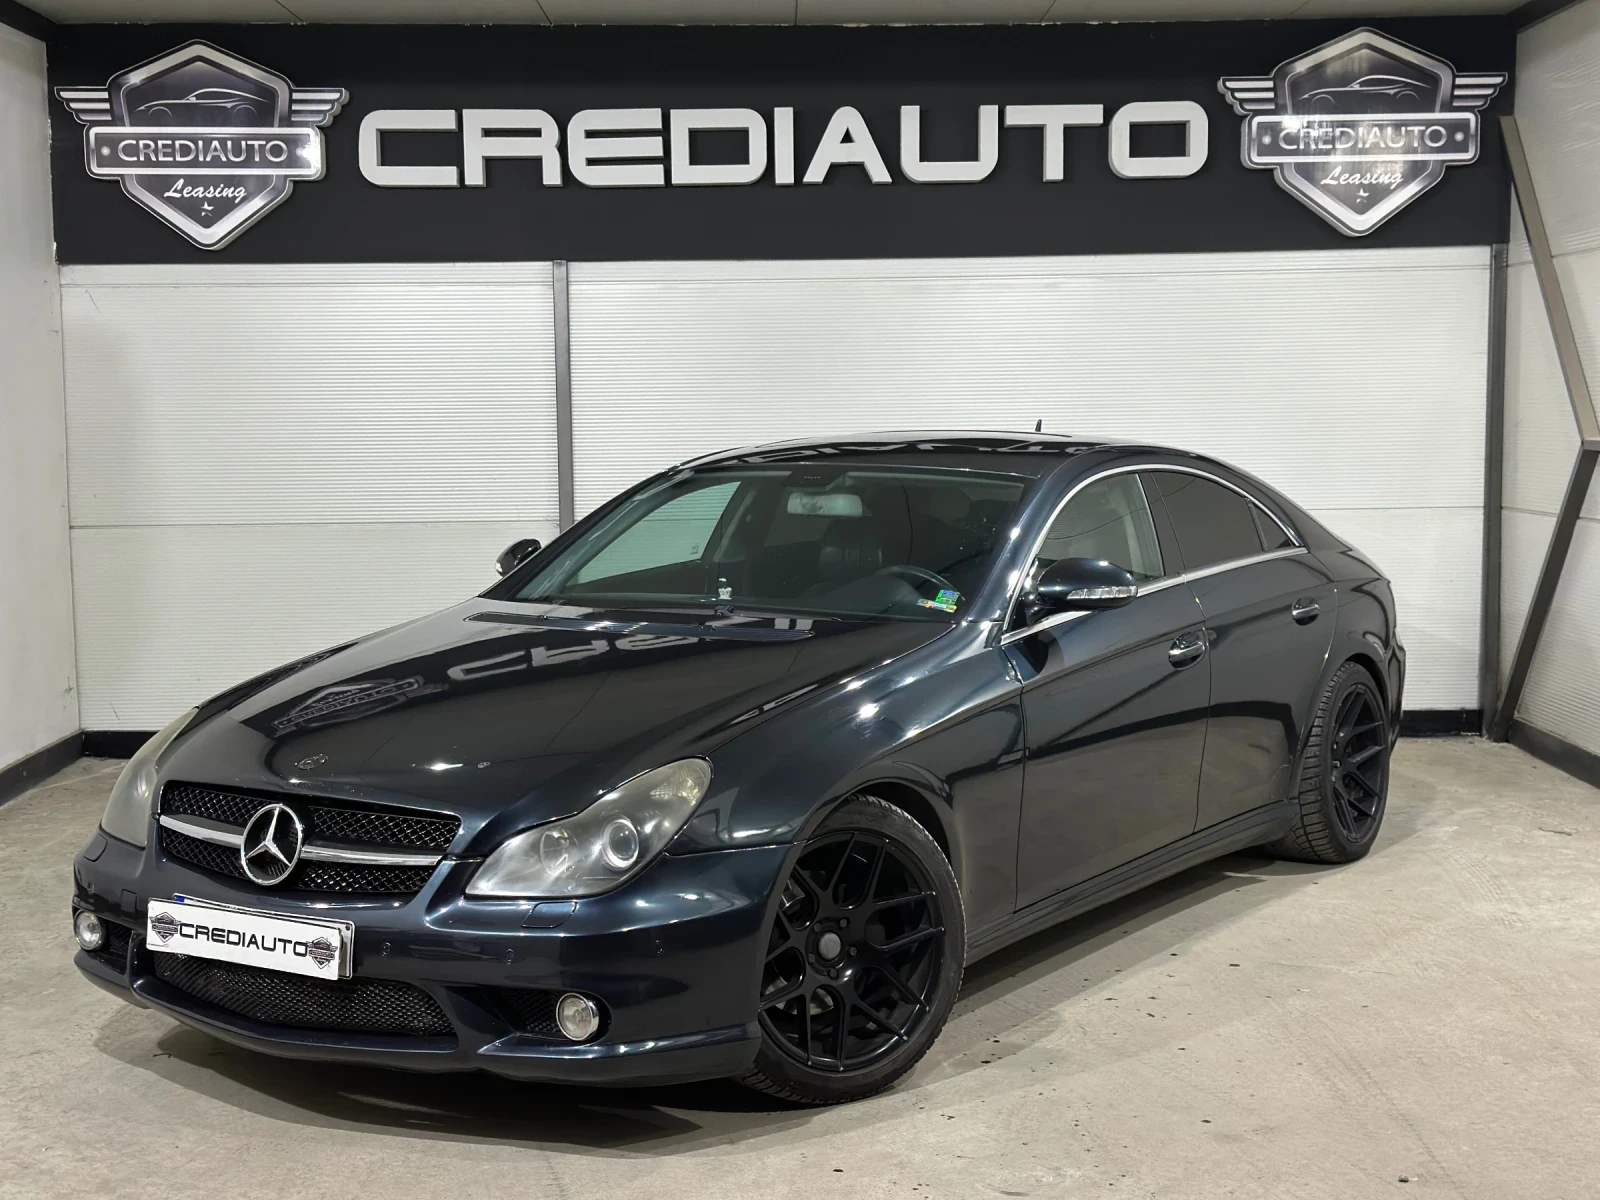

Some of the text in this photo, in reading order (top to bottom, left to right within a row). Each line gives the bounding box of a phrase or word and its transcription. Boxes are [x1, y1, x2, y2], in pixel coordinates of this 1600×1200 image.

[117, 139, 288, 162] CREDIAUTO
[359, 100, 1209, 187] CREDIAUTO
[1278, 126, 1448, 150] CREDIAUTO
[1320, 166, 1404, 190] Leasing
[163, 178, 248, 204] Leasing
[179, 923, 308, 957] CREDIAUTO
